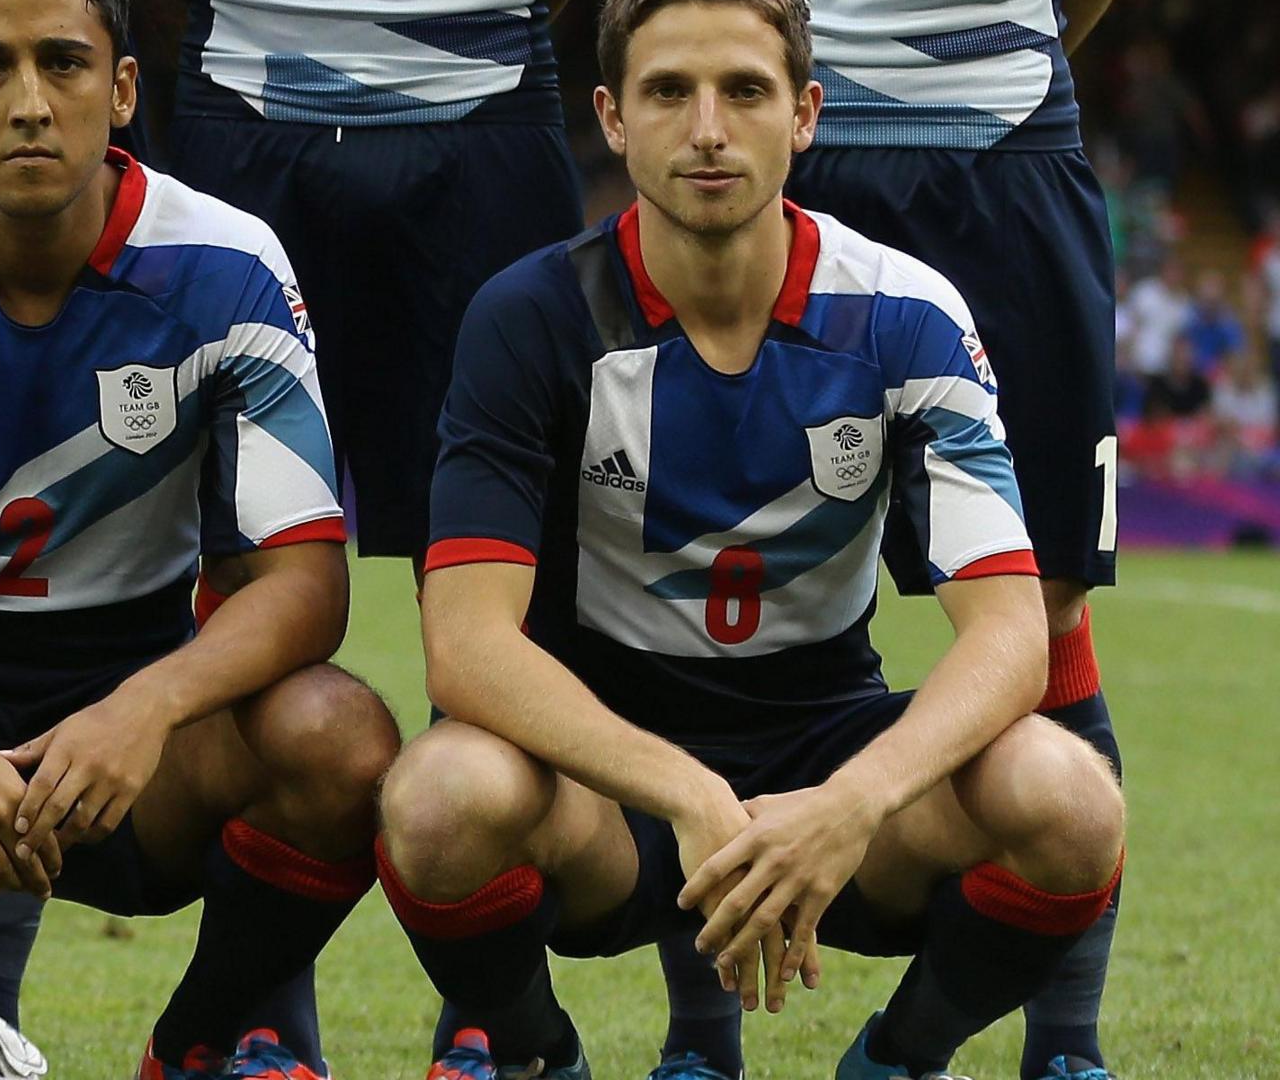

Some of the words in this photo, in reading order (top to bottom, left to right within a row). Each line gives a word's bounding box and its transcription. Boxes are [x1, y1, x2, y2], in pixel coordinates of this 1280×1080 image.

[119, 403, 144, 412] TEAM
[146, 402, 160, 410] GB
[831, 454, 855, 464] TEAM
[857, 450, 870, 459] GB
[582, 469, 645, 492] adidas
[705, 544, 763, 644] 8
